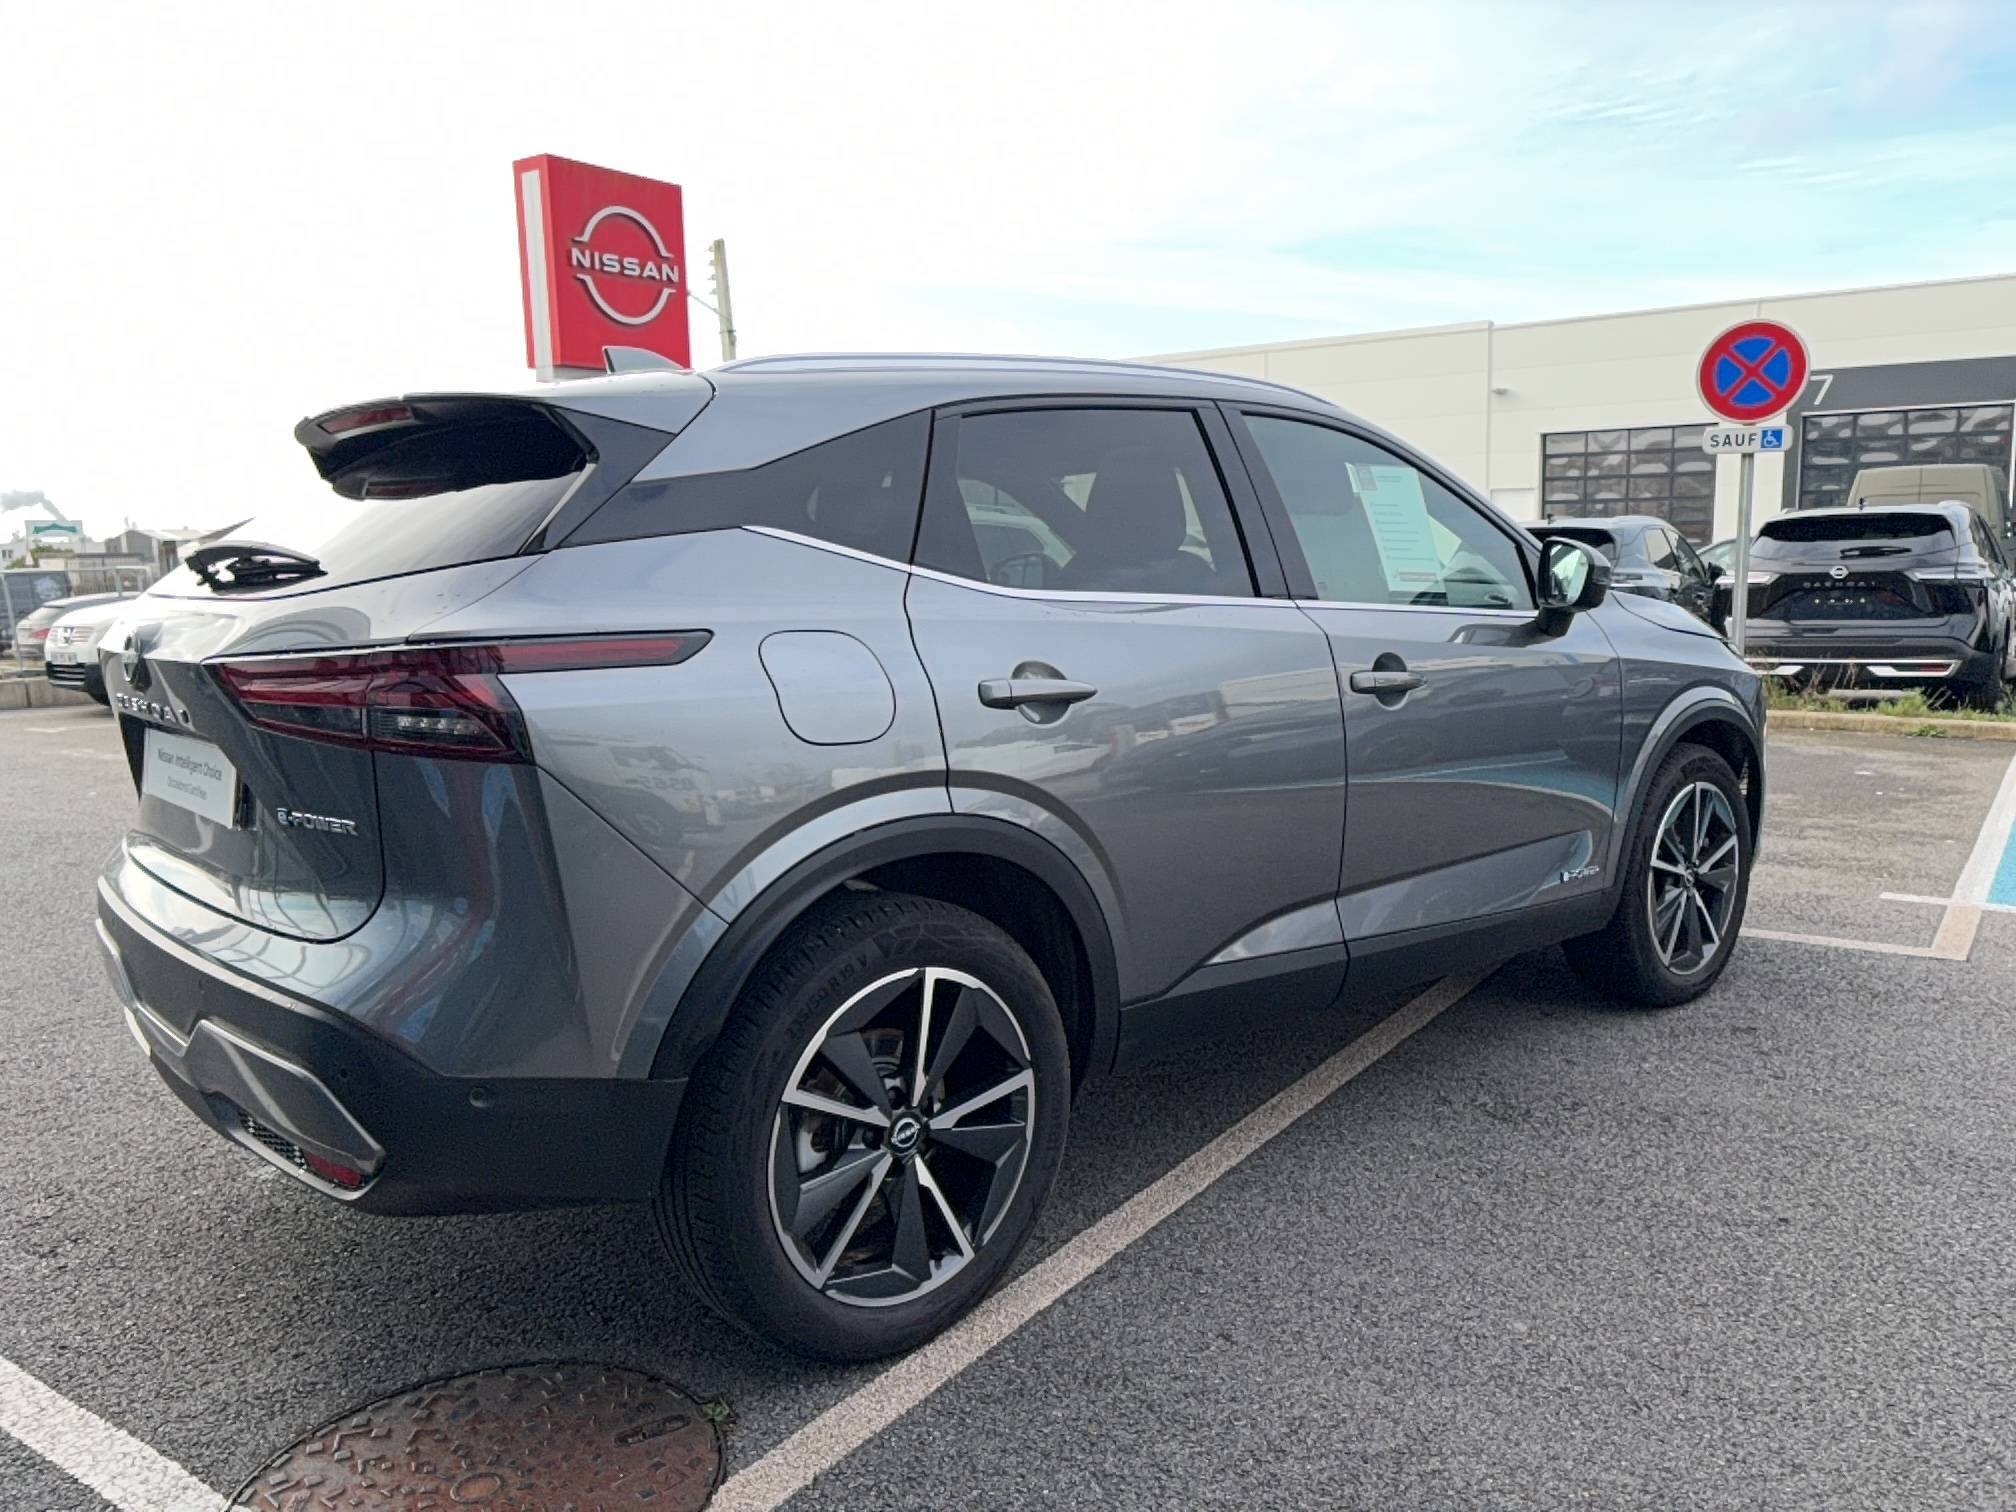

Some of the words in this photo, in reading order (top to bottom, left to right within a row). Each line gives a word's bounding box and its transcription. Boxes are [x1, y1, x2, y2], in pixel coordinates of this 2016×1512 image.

[571, 248, 678, 283] NISSAN
[1810, 374, 1833, 405] 7
[1709, 432, 1758, 448] SAUF
